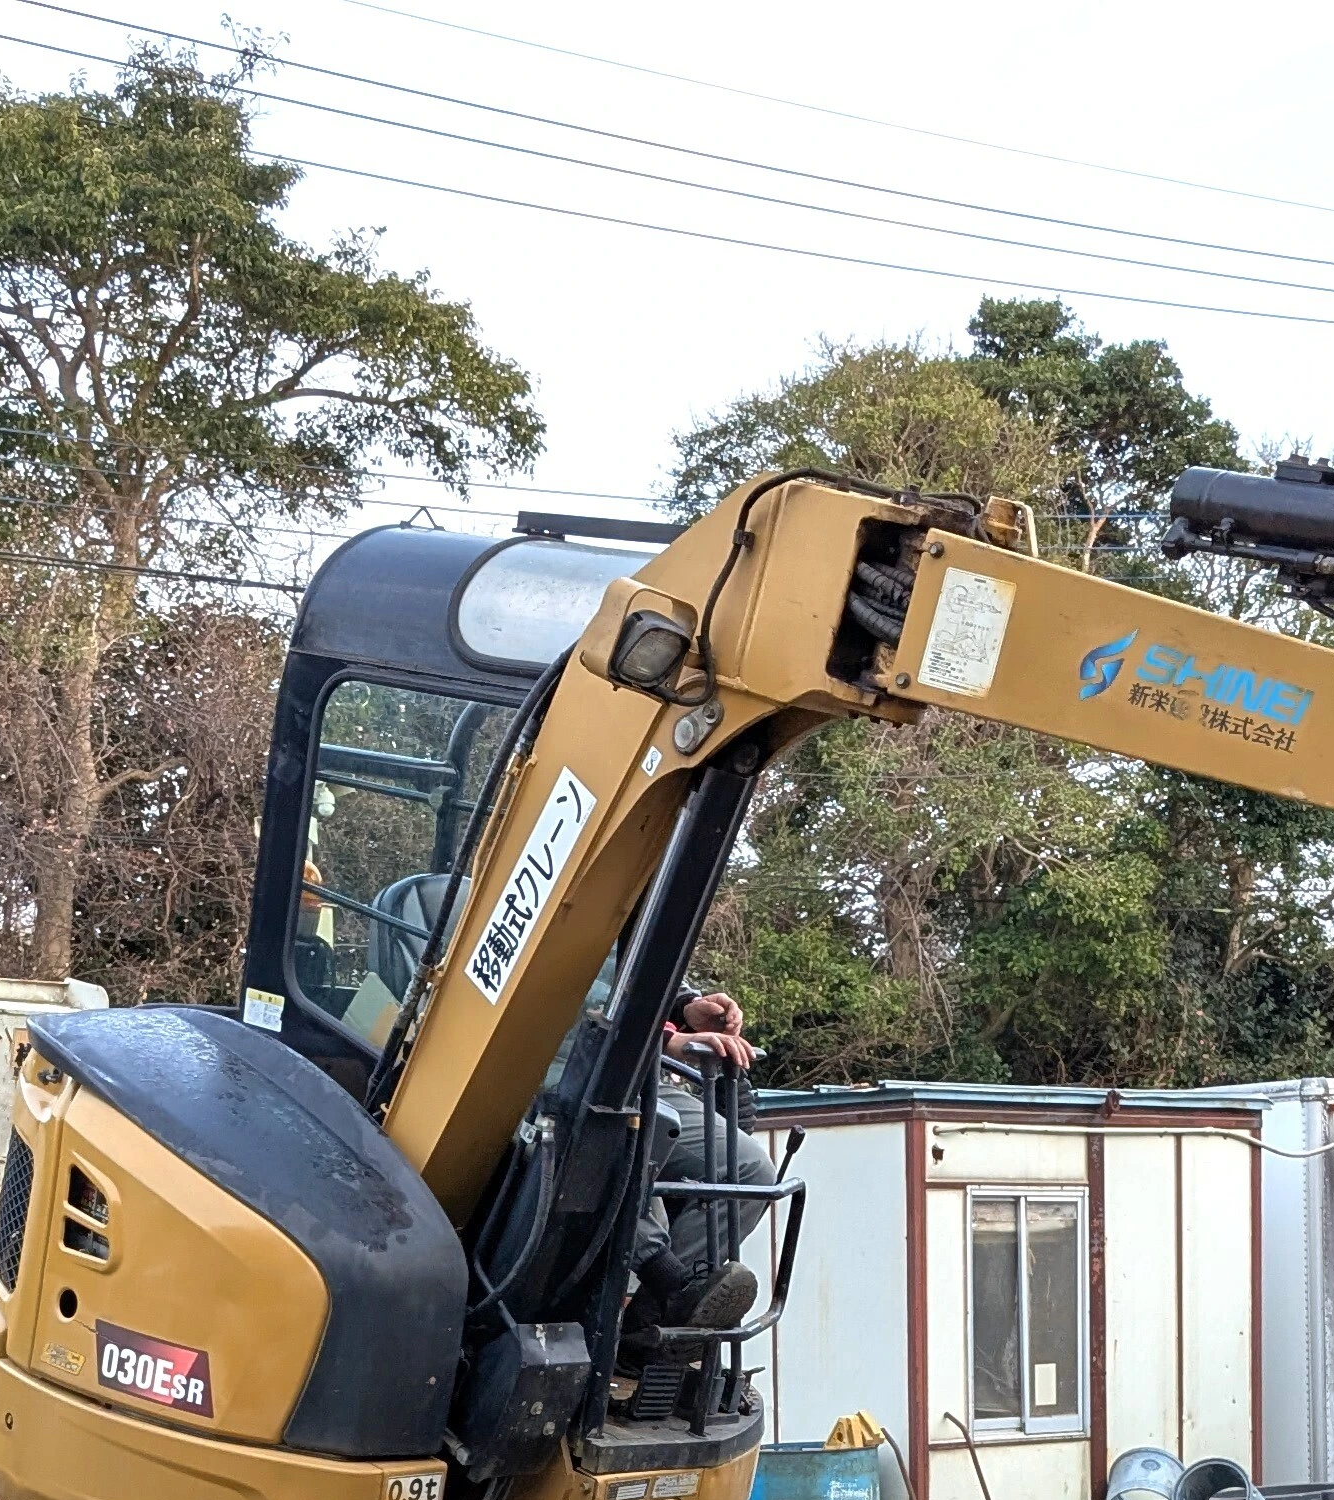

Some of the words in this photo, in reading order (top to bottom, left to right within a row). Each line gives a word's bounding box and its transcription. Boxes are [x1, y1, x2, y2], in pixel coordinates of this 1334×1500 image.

[1135, 642, 1315, 726] SHINEI
[473, 780, 583, 993] 移動式クレーン
[101, 1343, 205, 1405] 030ESR
